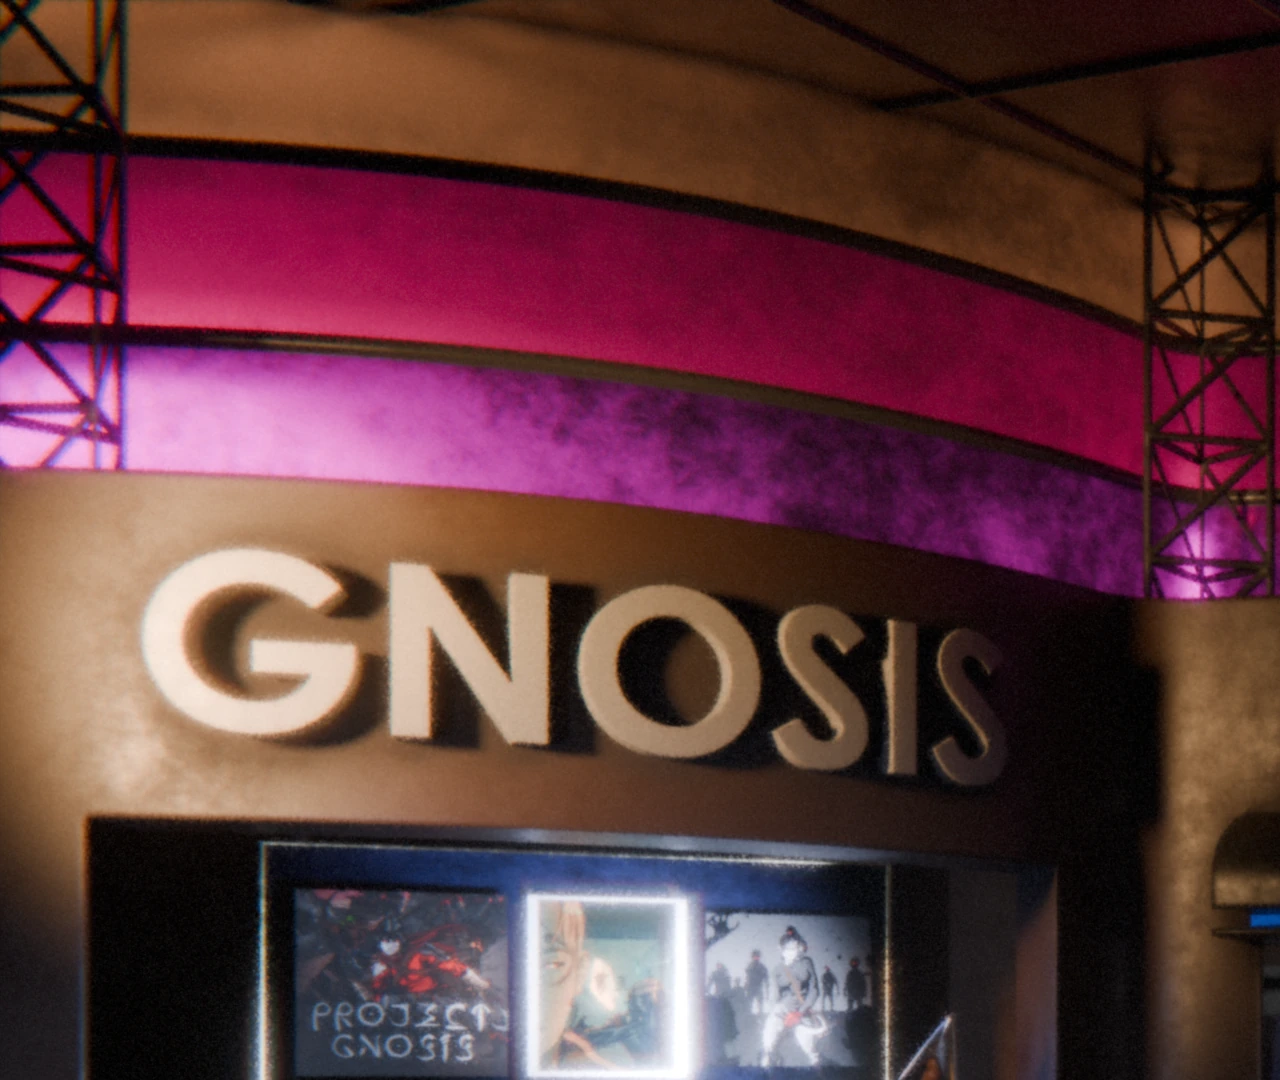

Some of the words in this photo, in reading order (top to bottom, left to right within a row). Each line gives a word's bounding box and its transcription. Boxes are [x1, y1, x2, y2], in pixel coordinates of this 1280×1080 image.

[141, 547, 1007, 786] GNOSIS
[312, 1002, 493, 1032] PROJECT
[331, 1034, 475, 1063] GNOSIS
